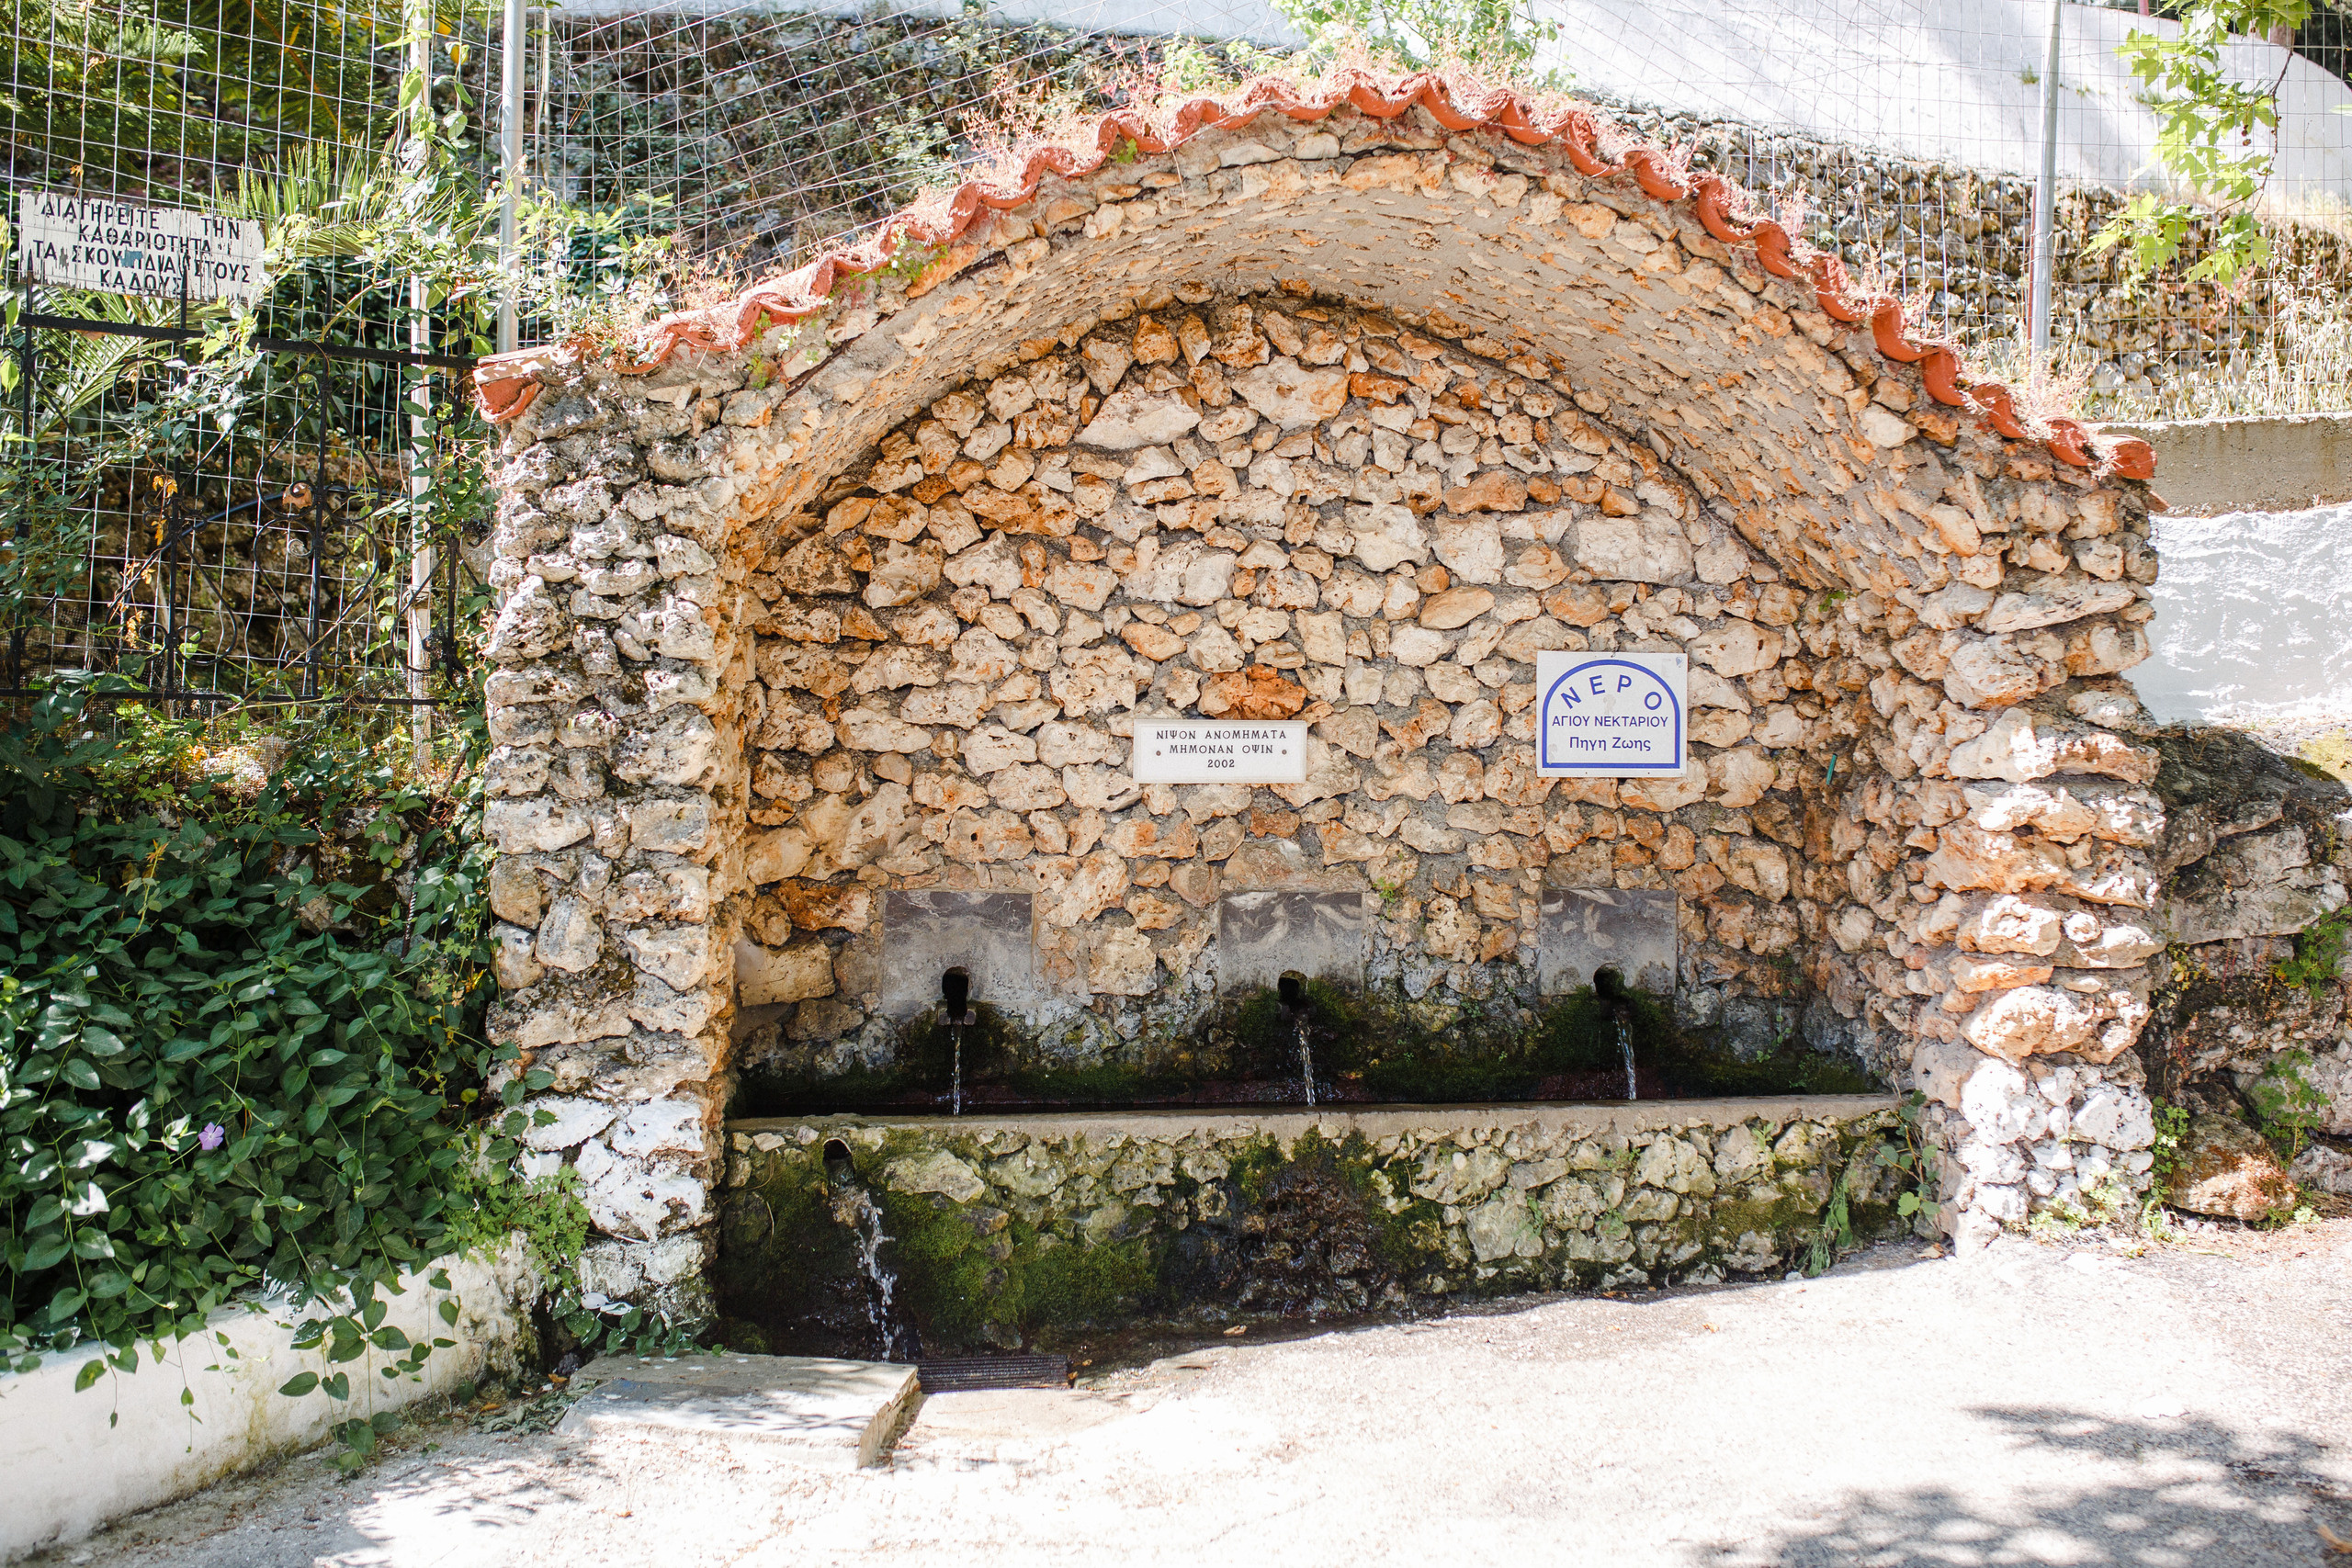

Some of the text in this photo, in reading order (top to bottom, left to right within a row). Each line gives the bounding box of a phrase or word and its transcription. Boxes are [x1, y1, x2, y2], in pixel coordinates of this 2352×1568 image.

[200, 217, 240, 241] ΤΗΝ
[78, 224, 211, 255] ΚΑΘΑΡΙΟΤΗΤΑ
[33, 239, 251, 283] ΤΑ ΣΚΟΥΙΔΙΑ ΣΤΟΥΣ
[100, 268, 183, 296] ΚΑΔΟΥΣ
[1560, 674, 1663, 711] ΝΕΡΟ
[1552, 716, 1668, 728] ΑΓΙΟΥ ΝΕΚΤΑΡΙΟΥ
[1156, 729, 1287, 739] ΝΙΨΟΝ ΑΝΟΜΗΜΑΤΑ
[1169, 745, 1273, 754] ΜΗΜΟΝΑΝ ΟΨΙΝ
[1569, 737, 1651, 751] Πηγη Ζωης
[1207, 760, 1235, 768] 2002
